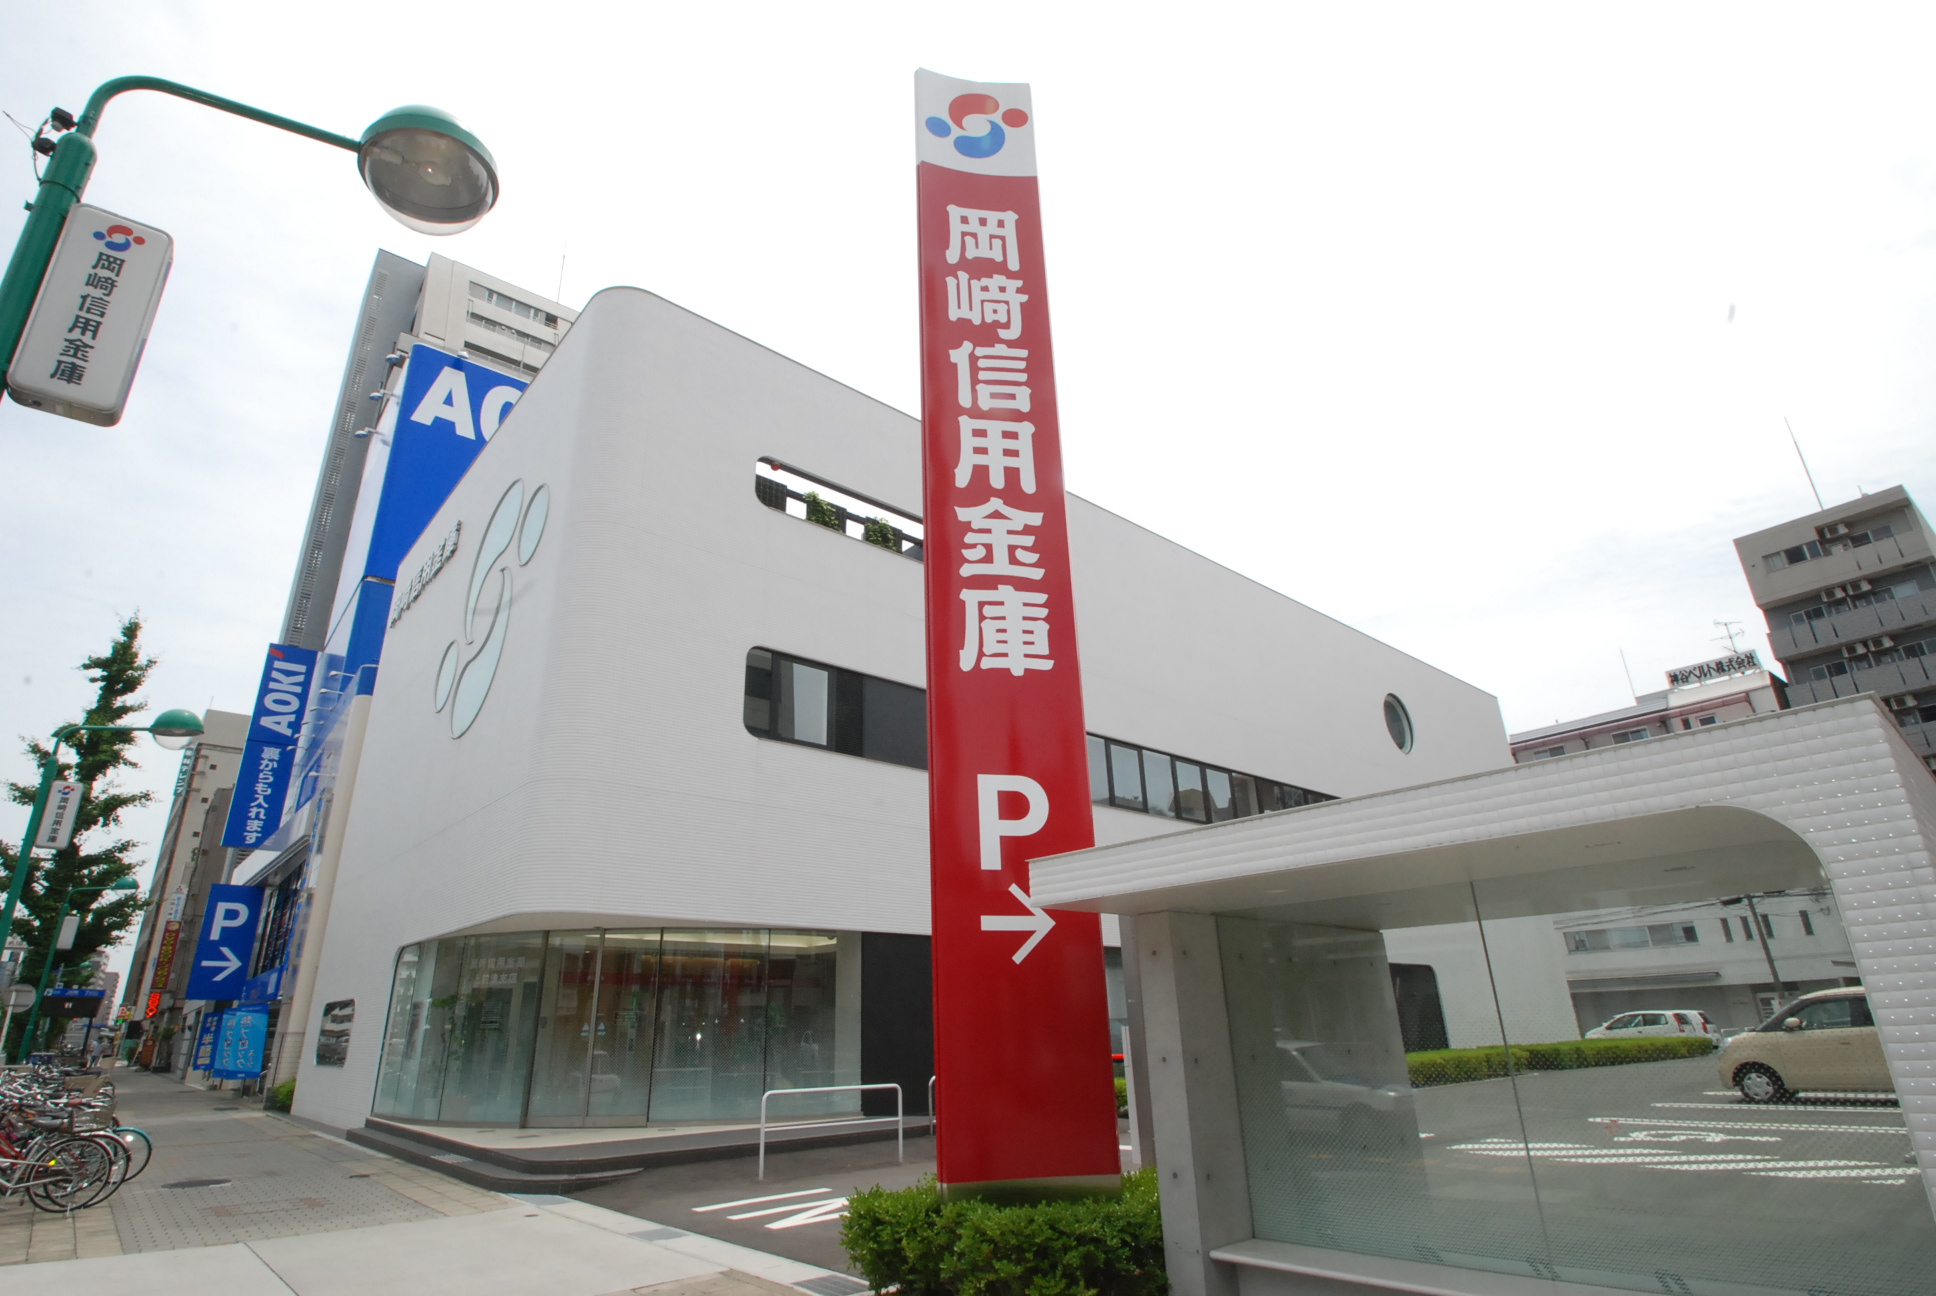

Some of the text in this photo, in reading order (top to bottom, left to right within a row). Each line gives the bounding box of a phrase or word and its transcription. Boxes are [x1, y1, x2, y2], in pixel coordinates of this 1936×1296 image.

[259, 660, 307, 737] AOKI
[1669, 652, 1757, 686] 神谷ベルト株式会社
[244, 747, 281, 845] 裏からも入れます
[977, 773, 1050, 870] P
[209, 902, 249, 940] P
